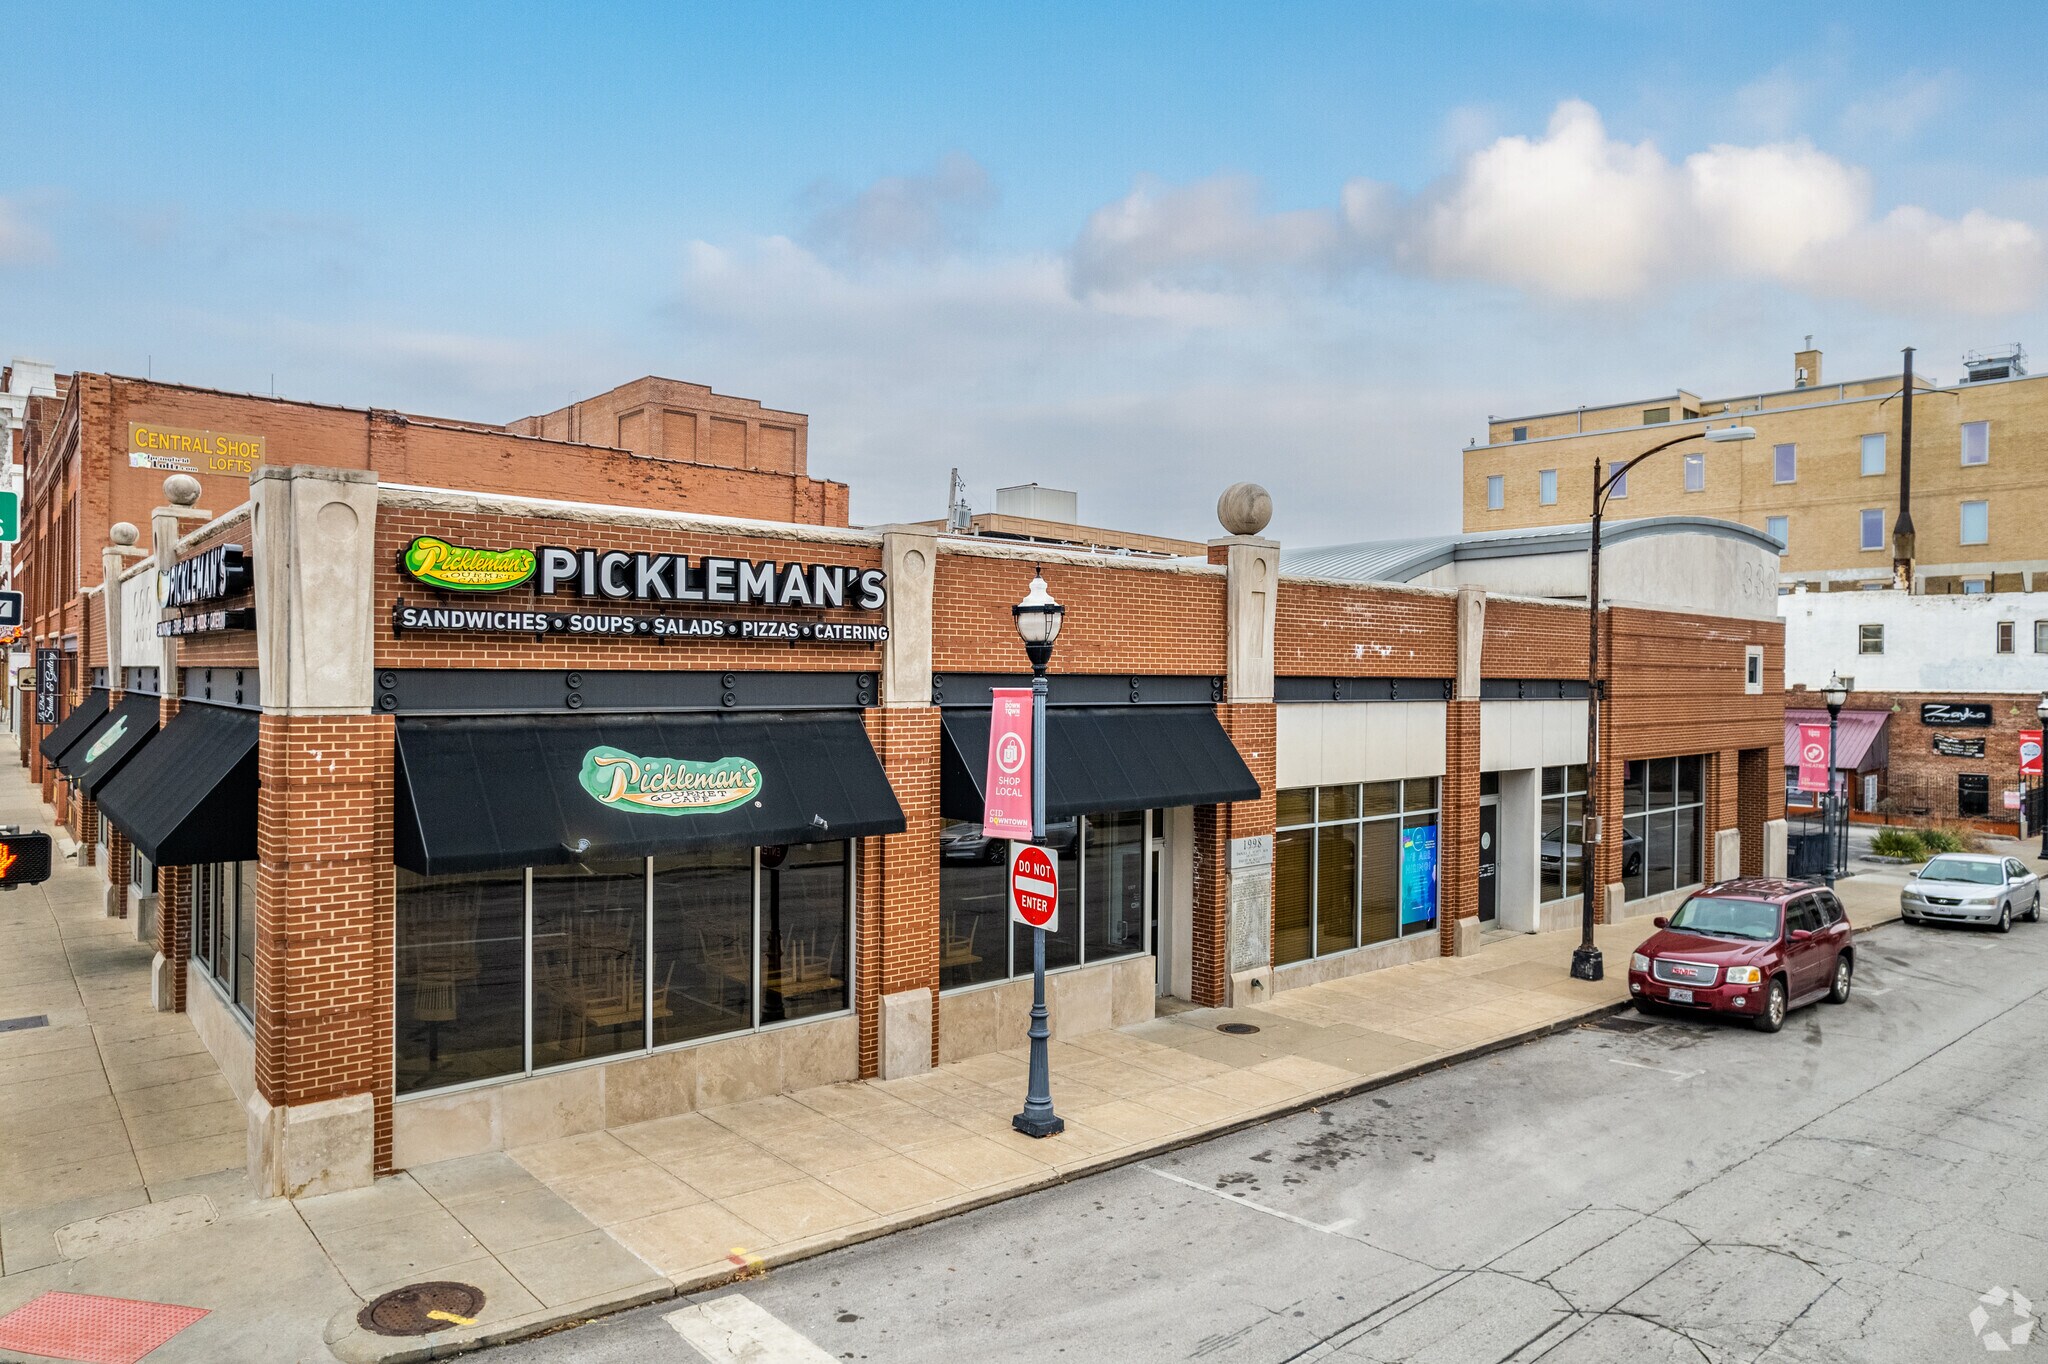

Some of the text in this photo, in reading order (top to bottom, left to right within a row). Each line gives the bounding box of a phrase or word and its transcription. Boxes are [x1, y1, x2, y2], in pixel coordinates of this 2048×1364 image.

[135, 428, 260, 459] CENTRAL SHOE
[209, 457, 252, 473] LOFTS
[412, 541, 534, 577] Pickleman's
[542, 546, 886, 611] PICKLEMAN'S
[402, 607, 890, 642] SANDWICHES SOUPS SALADS PIZZAS CATERING
[1924, 704, 1986, 721] Zayka
[593, 755, 757, 803] Pickleman's
[998, 776, 1020, 785] SHOP
[651, 790, 726, 802] GOURMET
[996, 788, 1022, 797] LOCAL
[989, 809, 1003, 817] CID
[989, 817, 1028, 826] DOWNTOWN
[1244, 838, 1262, 850] 1998
[1018, 859, 1051, 878] DO NOT
[1021, 895, 1048, 912] ENTER
[1672, 966, 1698, 976] GMC
